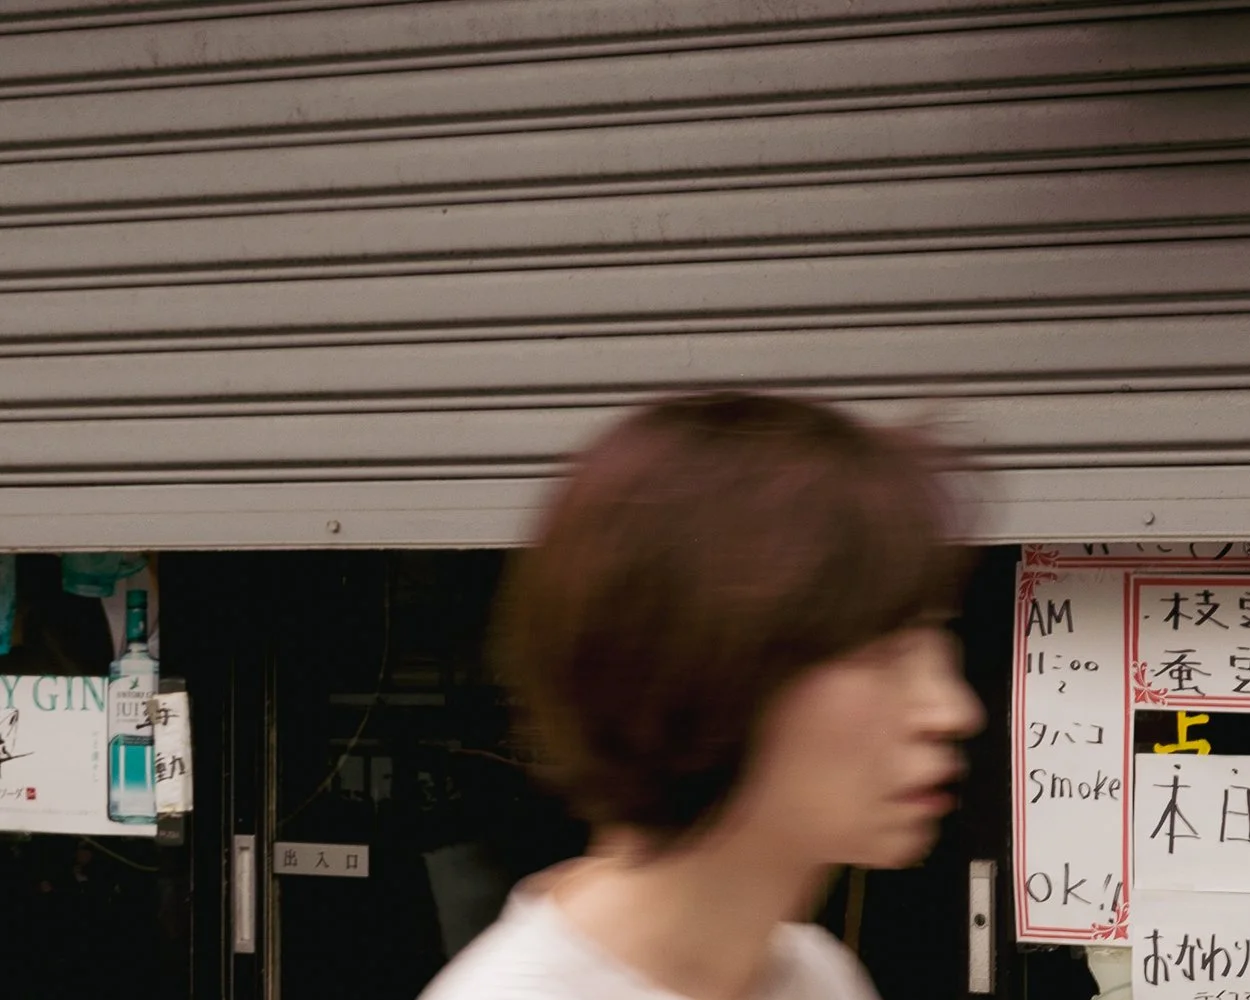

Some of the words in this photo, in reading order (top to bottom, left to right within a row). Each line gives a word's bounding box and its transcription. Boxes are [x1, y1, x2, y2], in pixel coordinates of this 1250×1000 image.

[1025, 598, 1074, 637] AM
[32, 675, 105, 712] GIN
[1028, 722, 1104, 749] タバコ
[283, 848, 358, 870] 出入口
